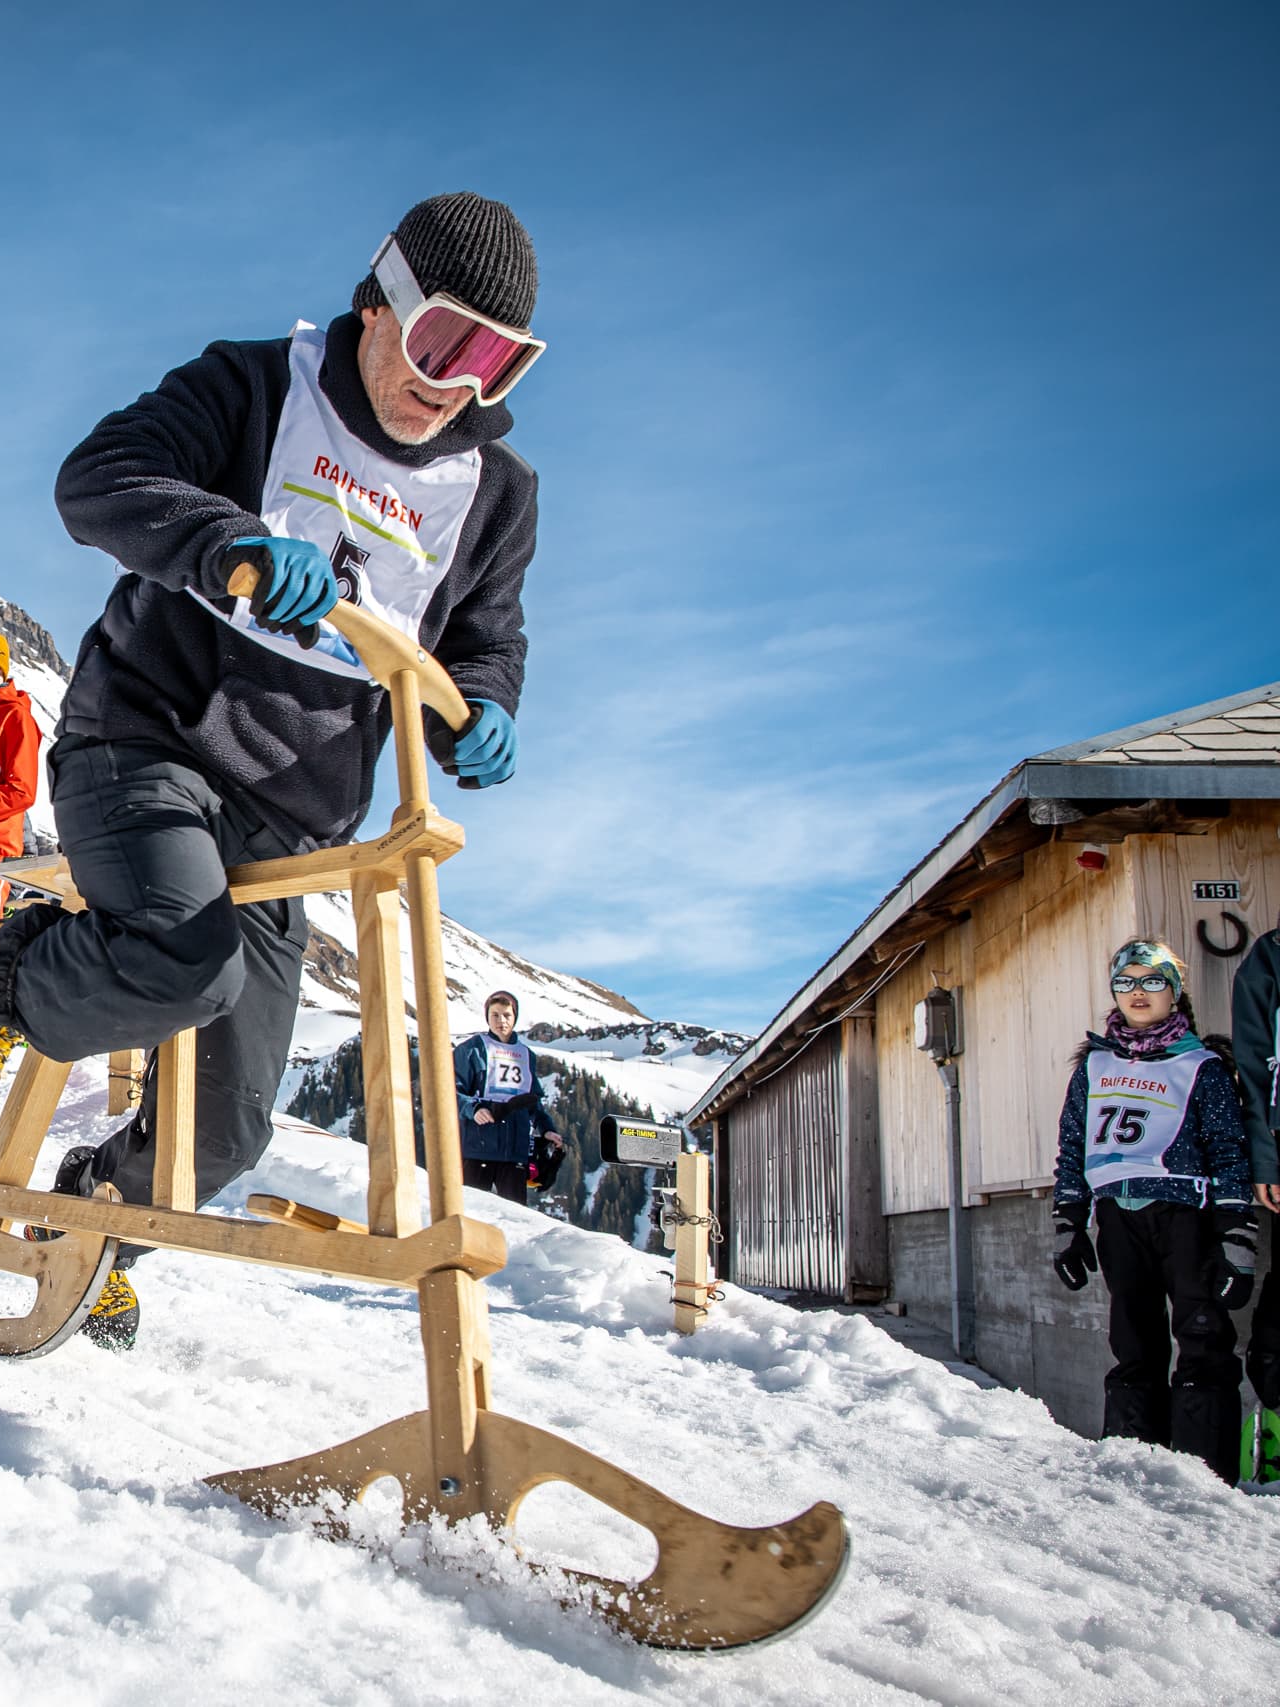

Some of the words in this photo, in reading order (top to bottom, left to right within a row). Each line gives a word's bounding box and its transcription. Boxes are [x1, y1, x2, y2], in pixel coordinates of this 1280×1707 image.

[312, 455, 423, 532] RAIFFEISEN
[1199, 885, 1234, 898] 1151
[499, 1064, 522, 1084] 73
[1100, 1076, 1168, 1095] RAIFFEISEN
[1093, 1105, 1151, 1146] 75
